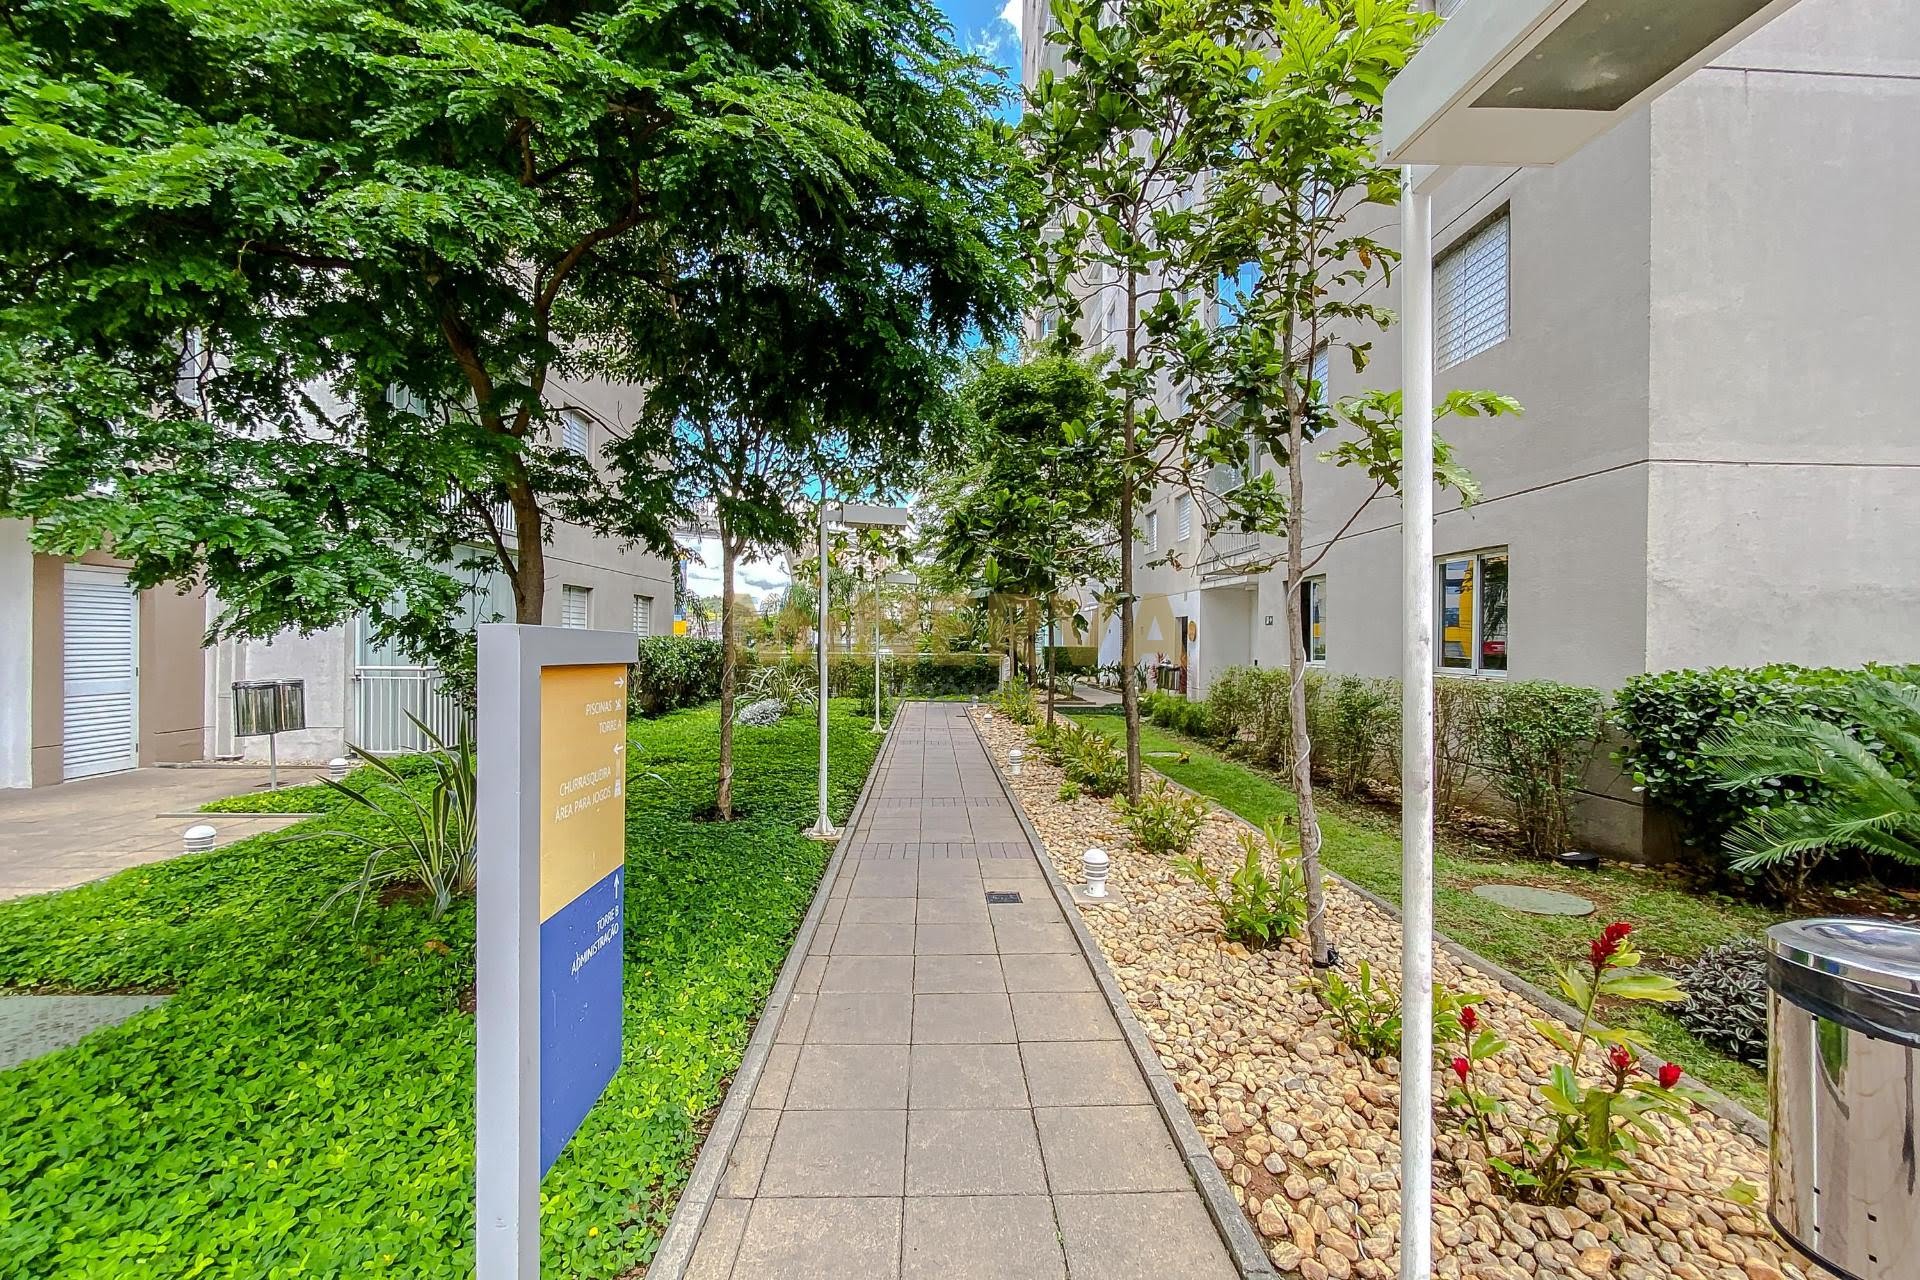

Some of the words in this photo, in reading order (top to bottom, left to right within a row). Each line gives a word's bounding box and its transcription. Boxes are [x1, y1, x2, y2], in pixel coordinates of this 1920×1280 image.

[599, 719, 617, 734] TORRE
[559, 766, 611, 797] CHURRASQUEIRA
[574, 795, 592, 814] PARA
[592, 785, 612, 806] JOGOS
[597, 908, 614, 933] TORRE
[571, 922, 619, 976] ADMINISTRAÇÃO
